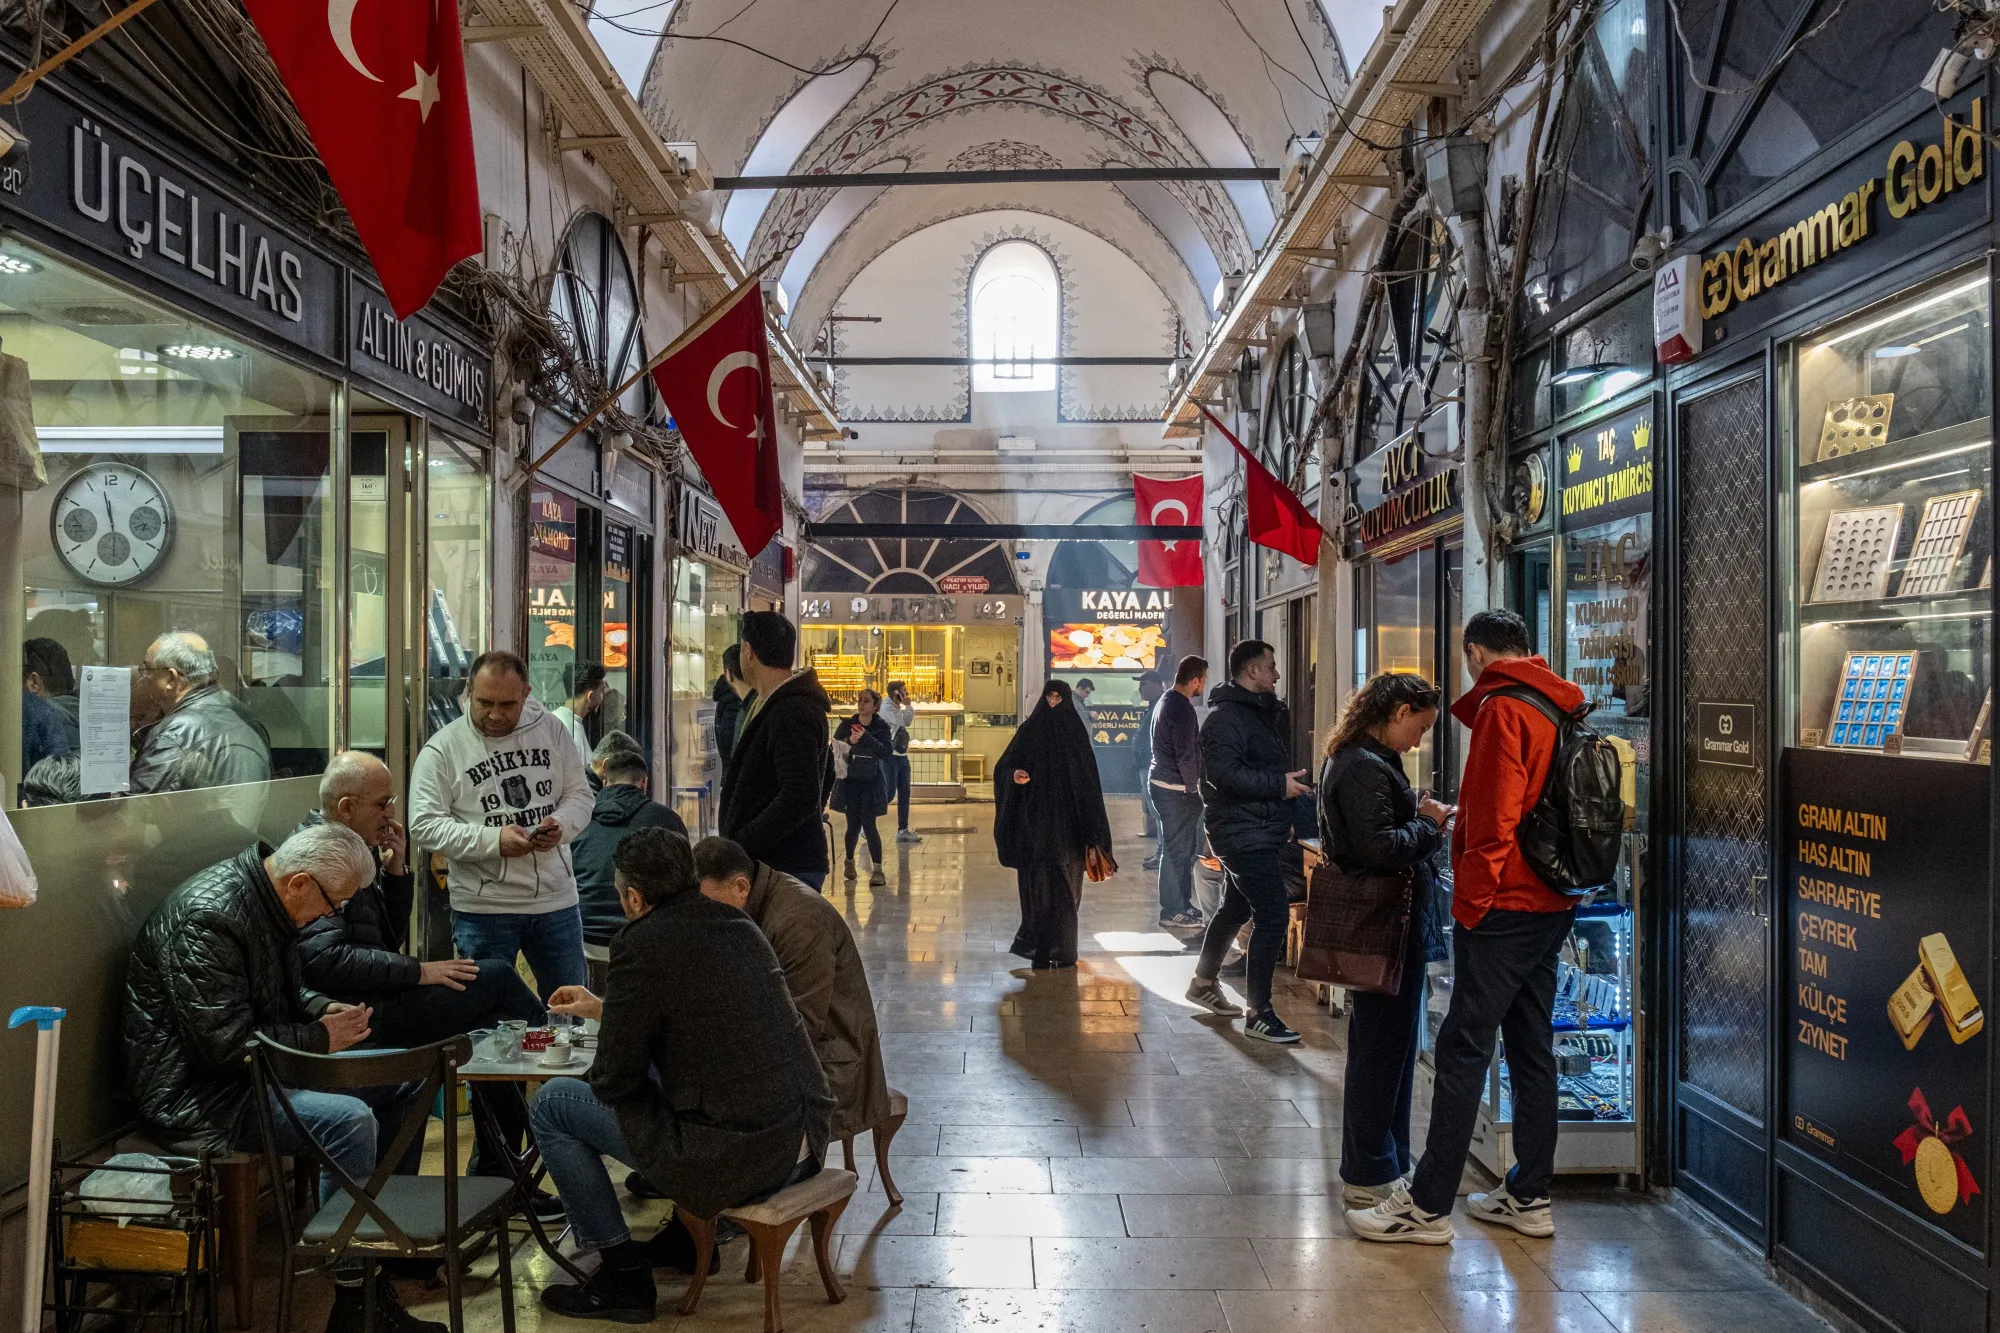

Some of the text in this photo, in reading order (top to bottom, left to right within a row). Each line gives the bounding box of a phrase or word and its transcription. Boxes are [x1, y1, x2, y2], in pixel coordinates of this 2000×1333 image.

[1733, 177, 1875, 302] Grammar
[1885, 96, 1984, 219] Gold
[73, 117, 302, 322] ÜÇELHAS
[361, 302, 484, 421] ALTIN & GÜMÜŞ
[1597, 427, 1616, 466] TAÇ
[104, 474, 118, 486] 12
[1380, 435, 1419, 494] AVCI
[542, 498, 562, 522] KAYA
[1360, 468, 1451, 543] KUYUMCULUK
[1562, 476, 1606, 515] KUYUMCU
[533, 522, 569, 551] DIAMOND
[1580, 532, 1636, 590] TAÇ
[1081, 591, 1141, 610] KAYA
[1096, 609, 1134, 620] DEĞERLİ
[1575, 596, 1639, 627] KUYUMCU
[530, 653, 559, 662] KAYA
[1577, 628, 1635, 661] TAMİRCİSİ
[1572, 666, 1598, 686] AYHAN
[1096, 711, 1145, 720] AYA ALT
[1704, 737, 1750, 754] Grammar Gold
[465, 748, 551, 787] BEŞİKTAŞ
[480, 779, 553, 813] 19 03
[1798, 803, 1888, 842] GRAM ALTIN
[1798, 839, 1871, 877] HAS ALTIN
[1798, 912, 1858, 951] ÇEYREK
[1798, 947, 1828, 979] TAM
[1798, 983, 1848, 1025] KÜLÇE
[1806, 1122, 1835, 1147] Grammar
